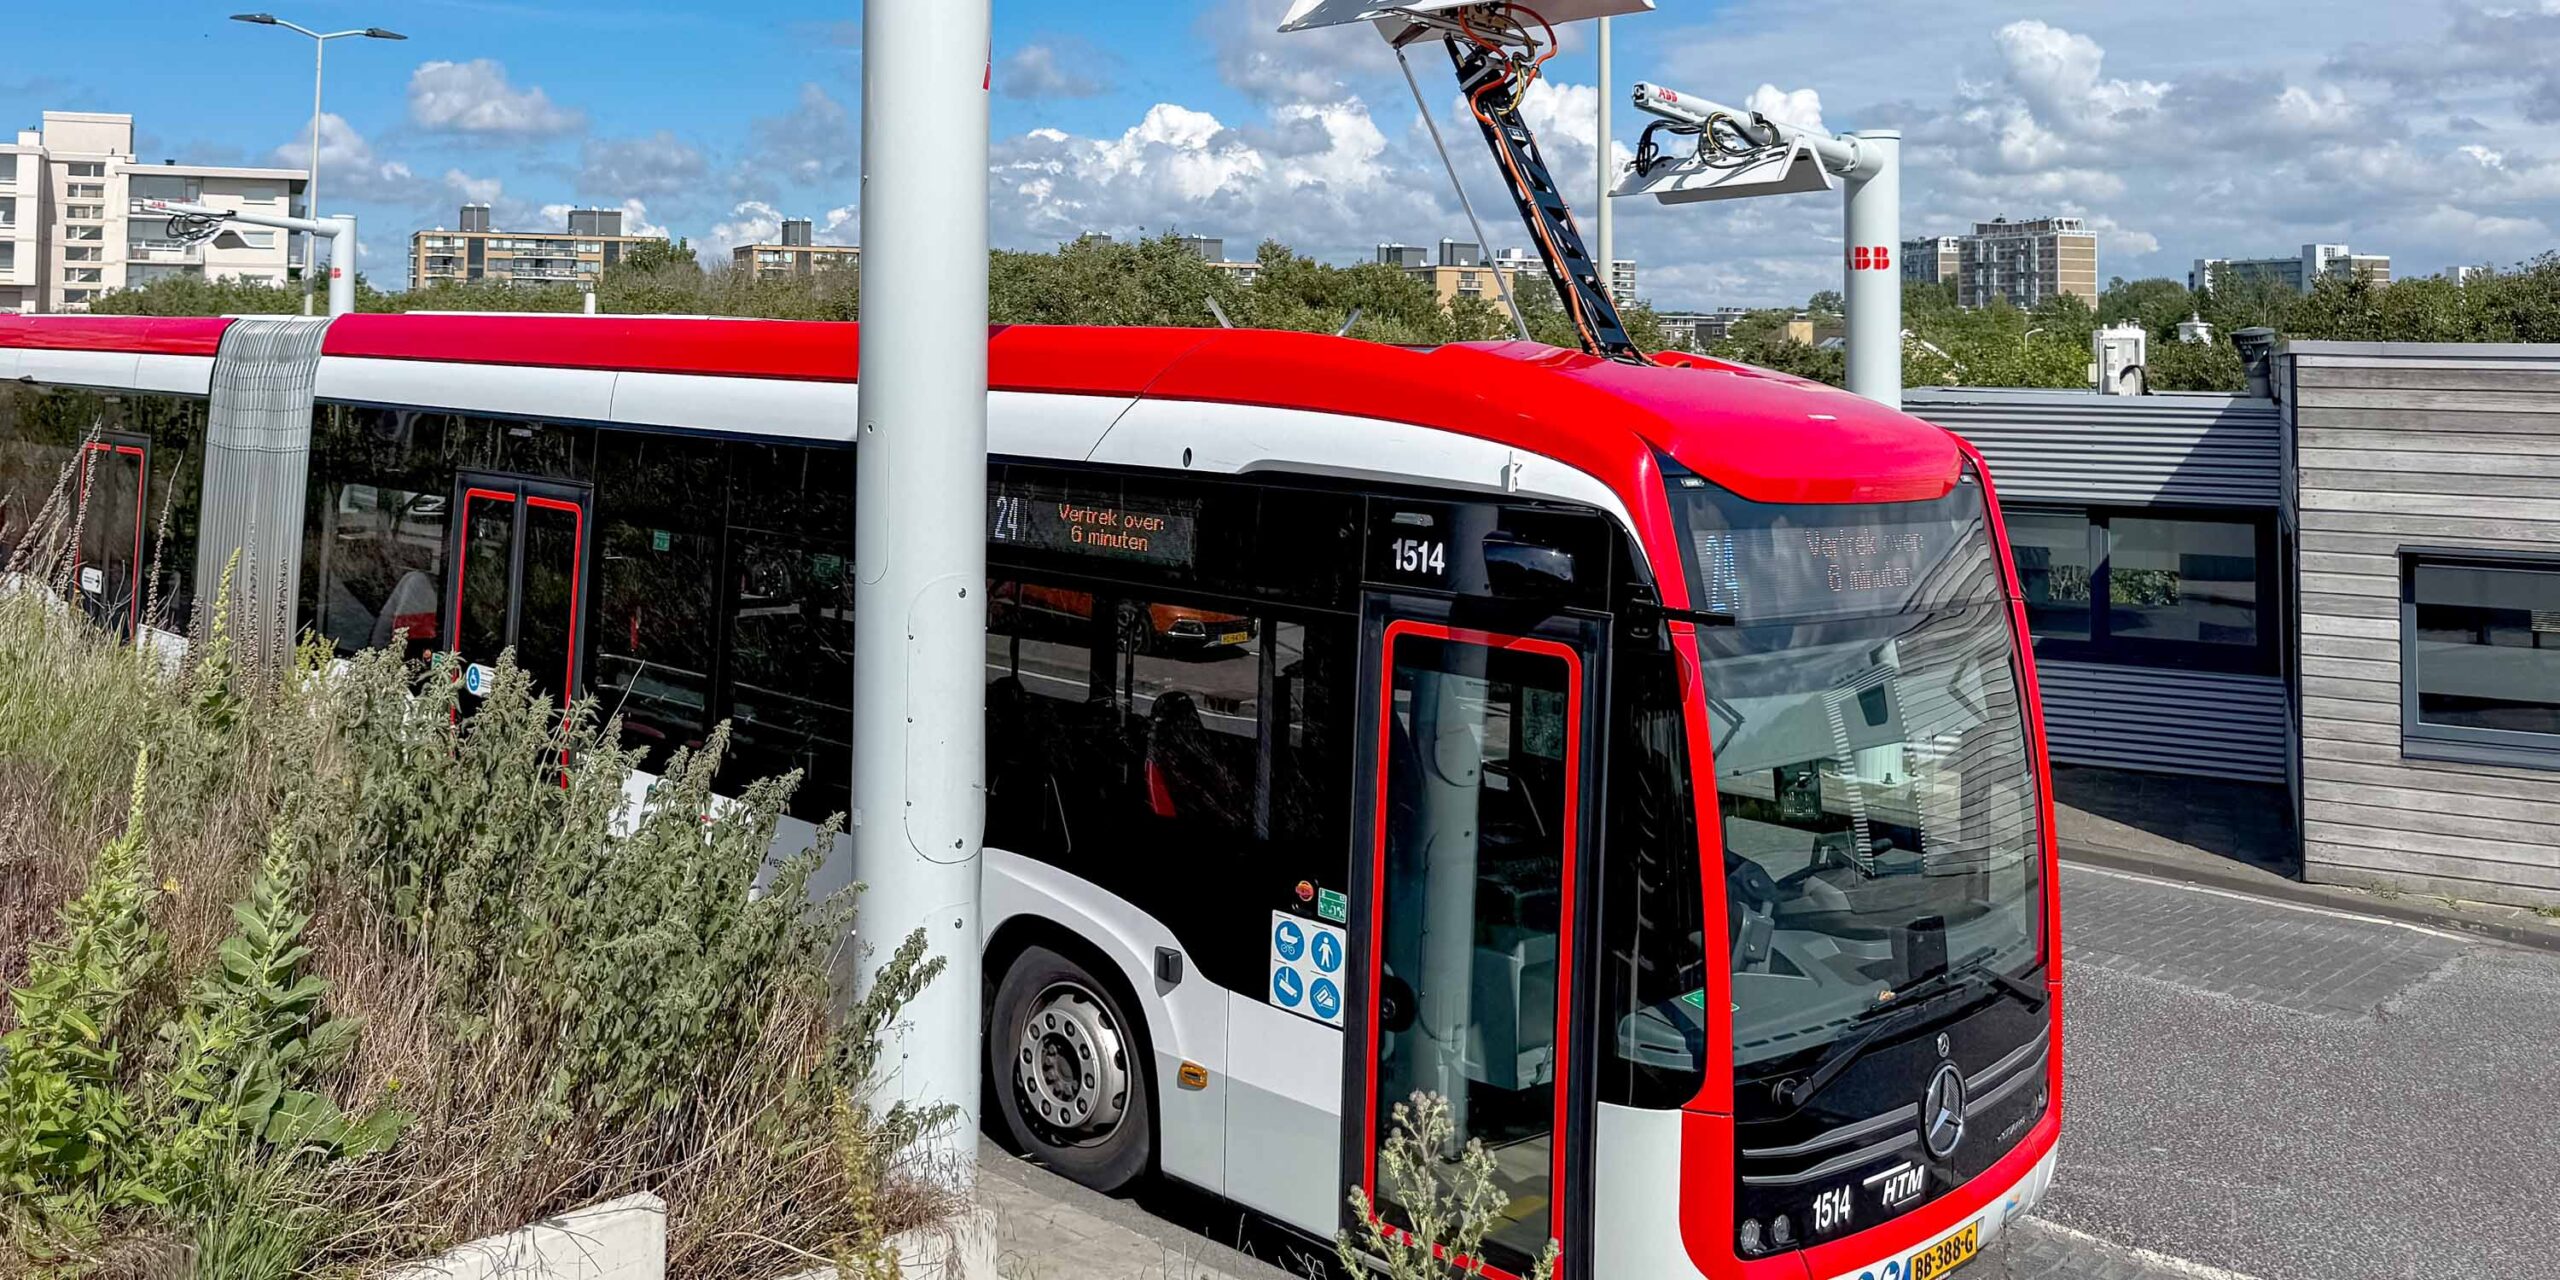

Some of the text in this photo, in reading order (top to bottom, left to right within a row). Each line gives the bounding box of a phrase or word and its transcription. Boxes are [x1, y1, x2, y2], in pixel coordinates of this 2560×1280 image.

[1659, 88, 1677, 102] ABB
[995, 496, 1018, 540] 24
[1059, 503, 1164, 530] Vertrek over:
[1071, 525, 1147, 551] 6 minuten
[1805, 529, 1877, 557] Vertrek
[1392, 538, 1445, 575] 1514
[1706, 535, 1740, 611] 24
[1827, 561, 1912, 591] 6 minuten
[1813, 1164, 1925, 1230] 1514 HTM
[1915, 1228, 1973, 1280] BB-388-G
